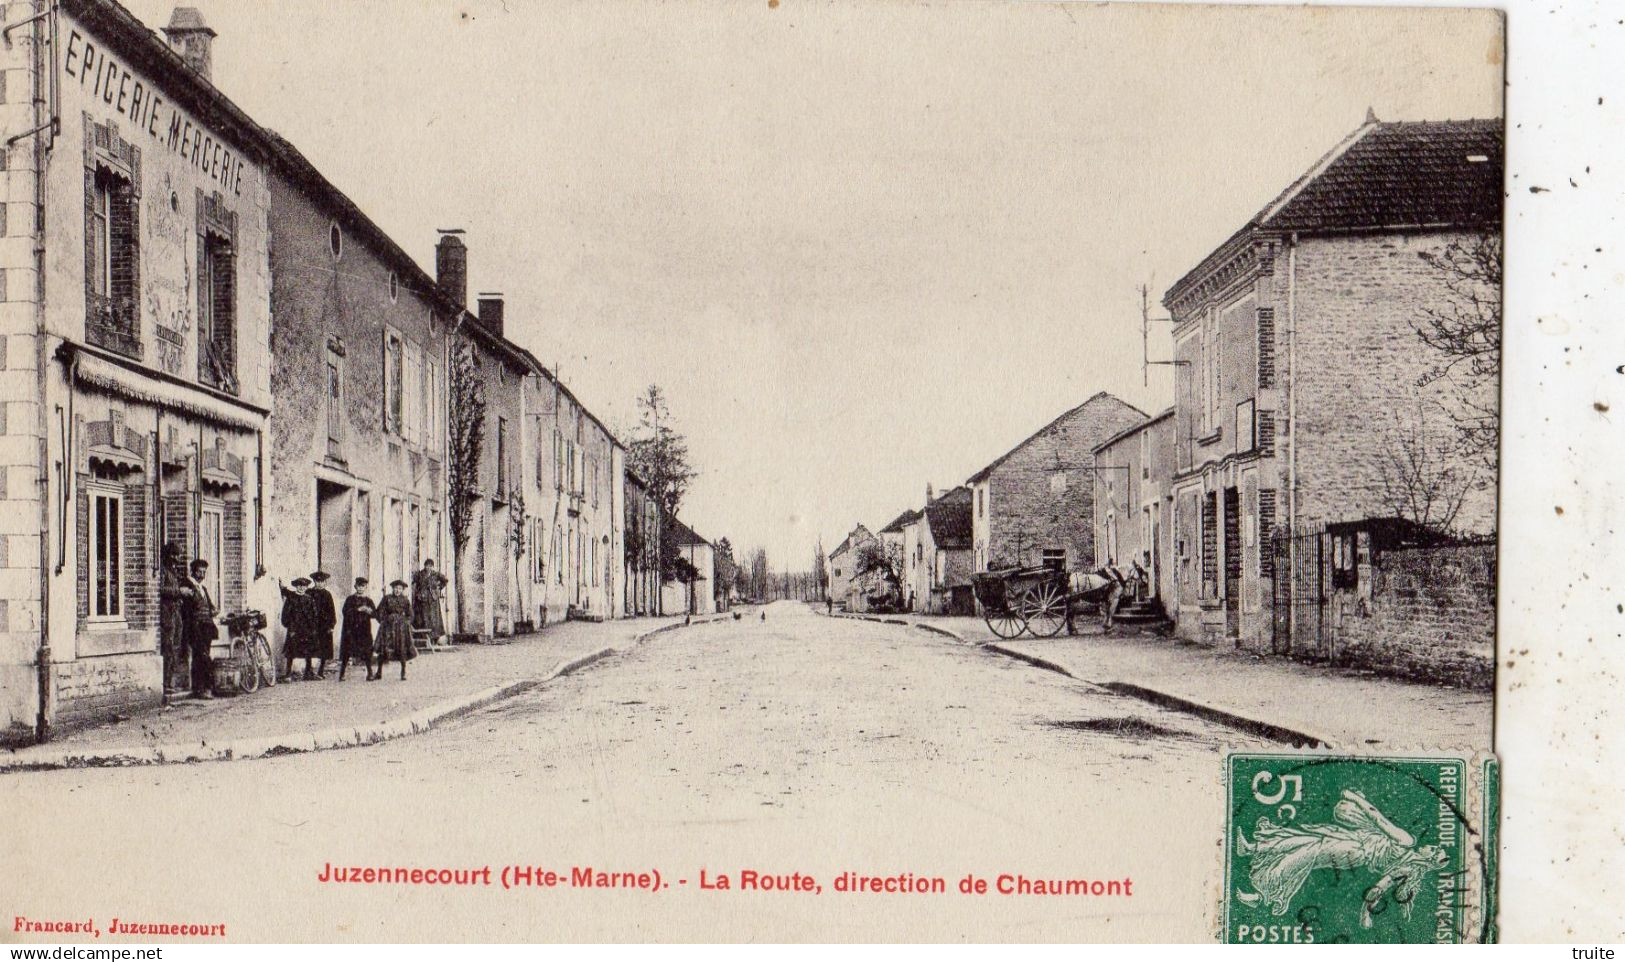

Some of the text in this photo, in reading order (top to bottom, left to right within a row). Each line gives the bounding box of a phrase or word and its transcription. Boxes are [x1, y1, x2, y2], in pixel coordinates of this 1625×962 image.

[167, 109, 245, 197] MERCERIE
[1437, 766, 1458, 849] REPUBLIQUE
[319, 864, 491, 886] Juzennecourt
[501, 866, 669, 893] (Hte-Marne).
[700, 870, 730, 890] La
[740, 870, 822, 894] Route,
[833, 872, 945, 894] direction
[959, 875, 988, 894] de
[996, 874, 1132, 897] Chaumont
[13, 916, 226, 937] Francard, Juzennecourt
[1238, 923, 1315, 944] POSTES
